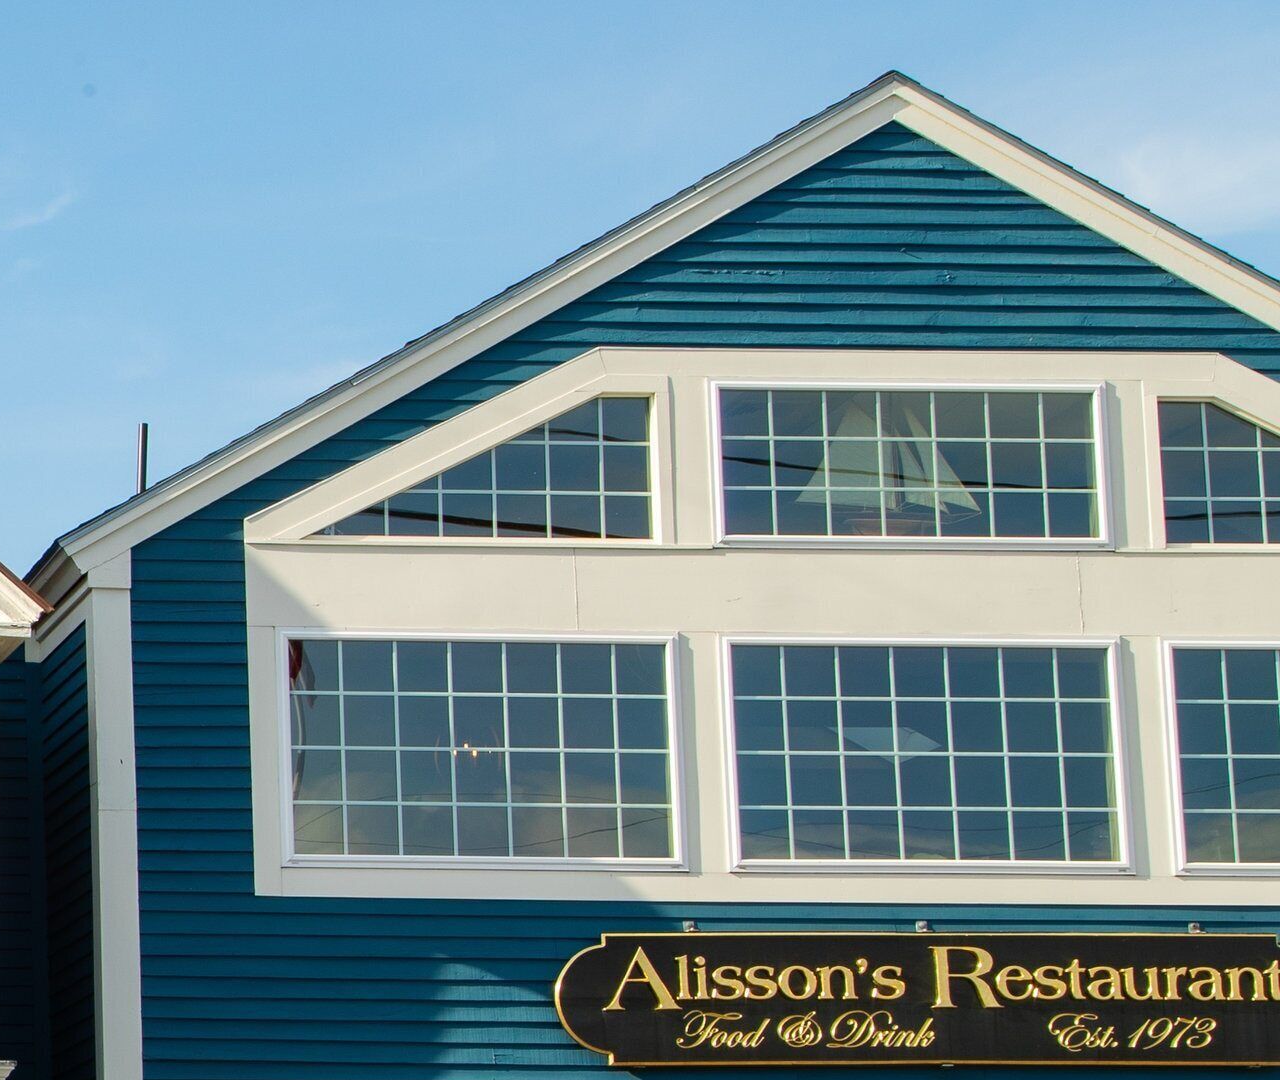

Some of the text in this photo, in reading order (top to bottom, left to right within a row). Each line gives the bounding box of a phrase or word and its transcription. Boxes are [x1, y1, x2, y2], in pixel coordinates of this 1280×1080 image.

[603, 944, 1280, 1011] Alisson's Restaurant
[676, 1008, 936, 1050] Food & Drink
[1048, 1013, 1217, 1050] Est. 1973
